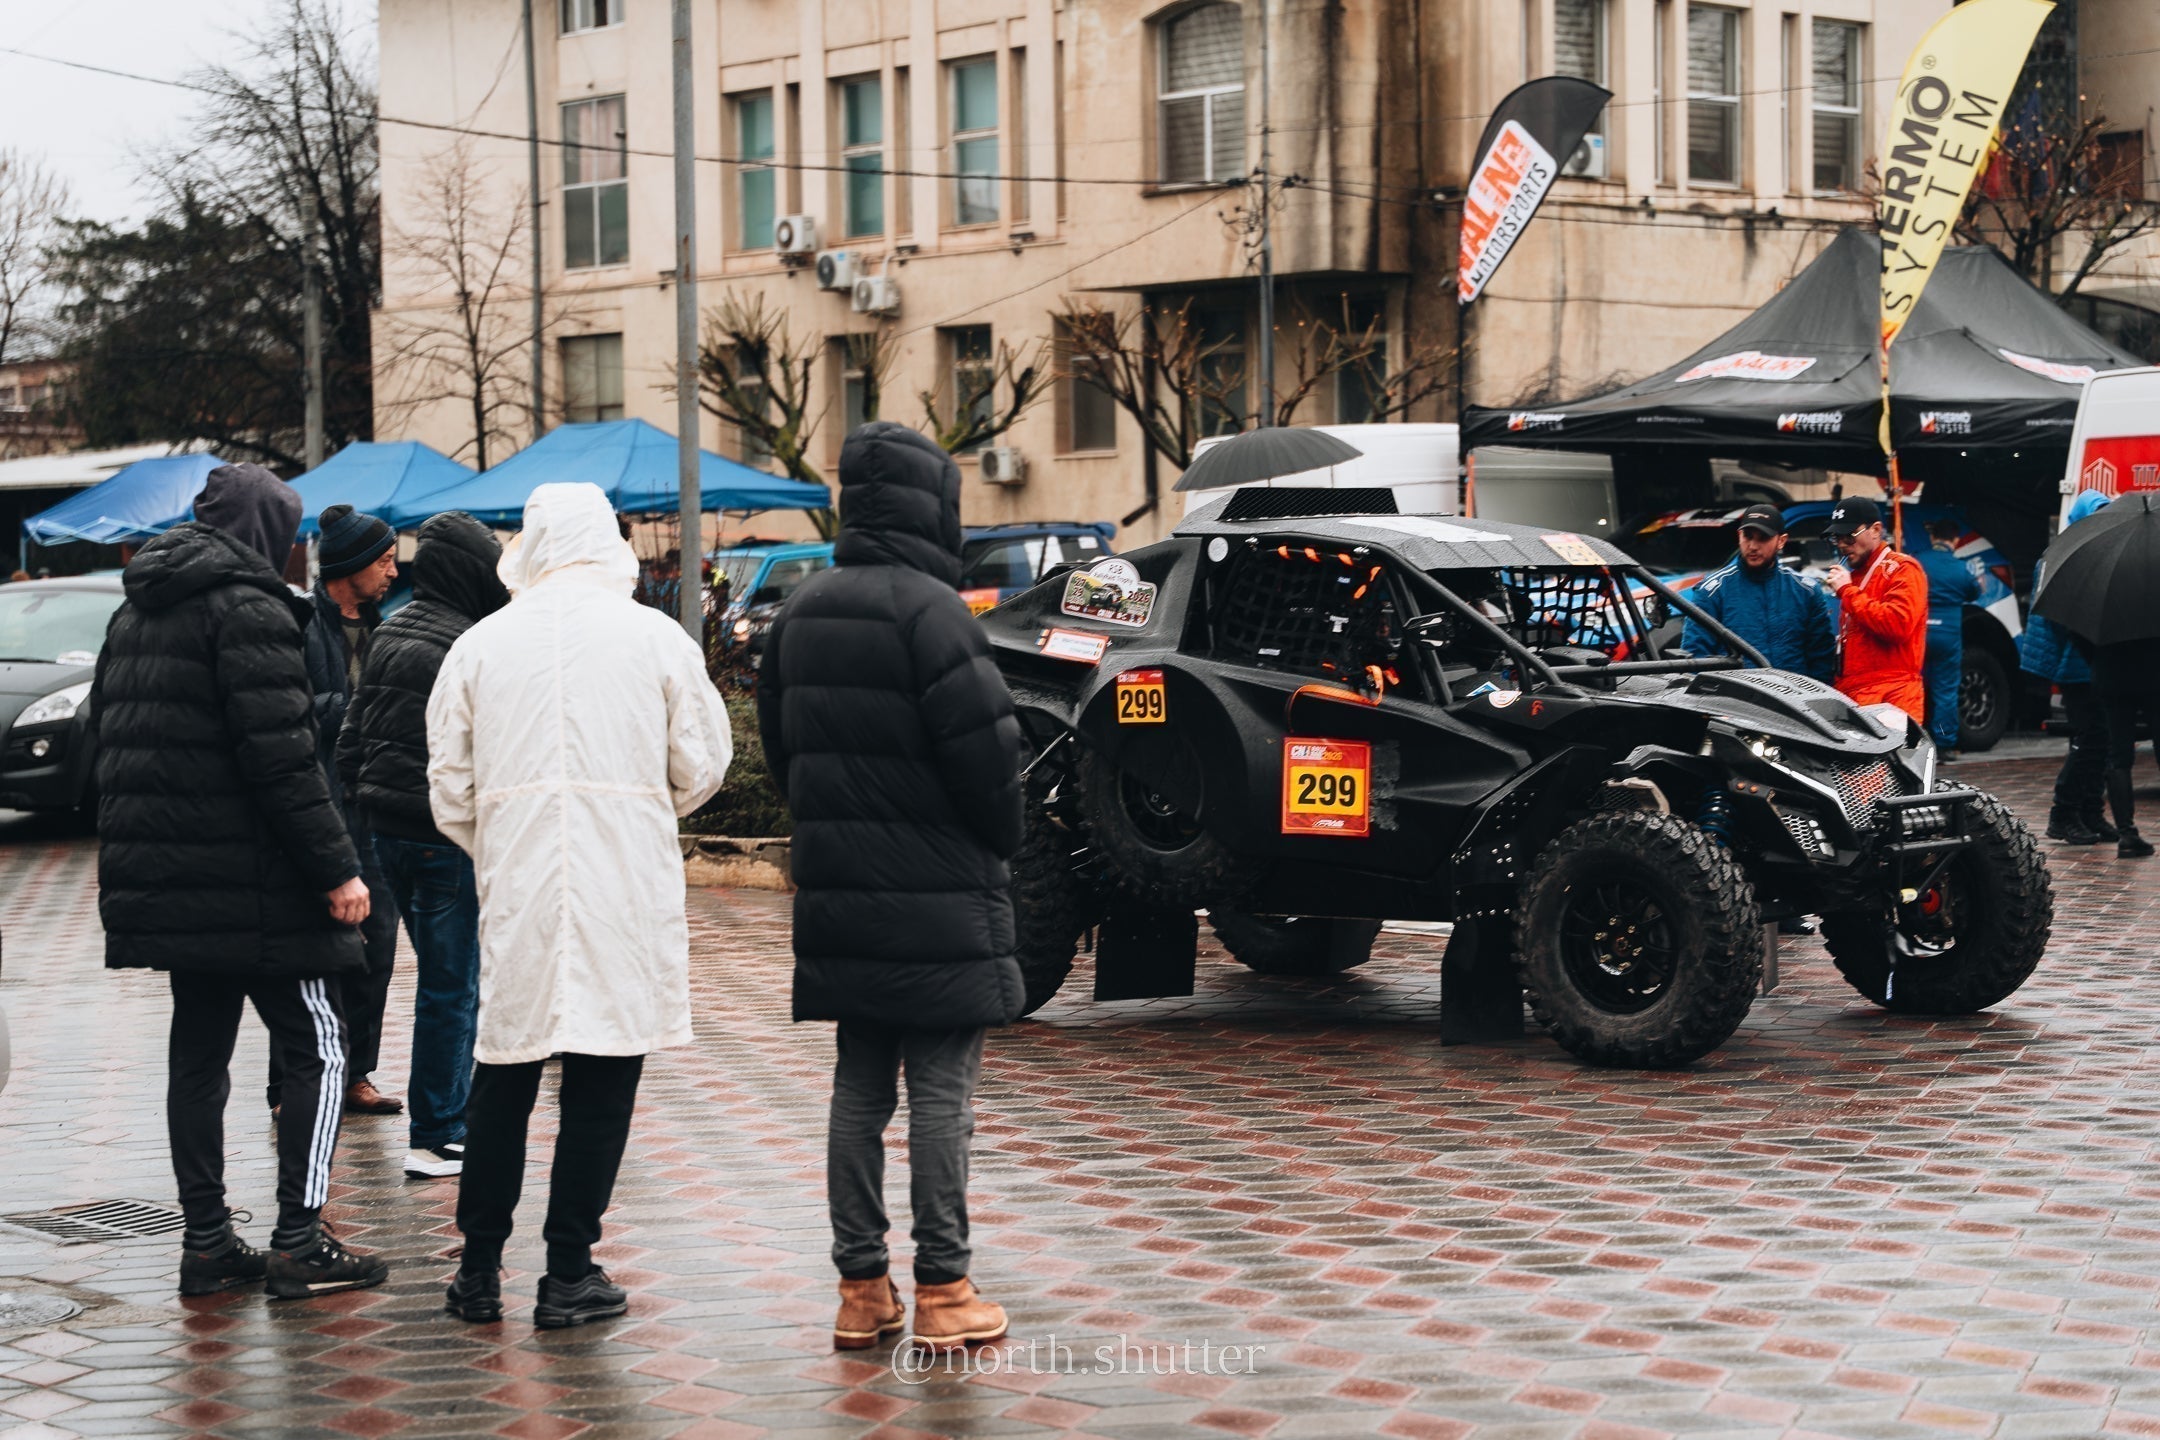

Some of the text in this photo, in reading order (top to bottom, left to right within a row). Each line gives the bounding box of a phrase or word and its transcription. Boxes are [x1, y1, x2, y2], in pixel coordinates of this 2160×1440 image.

[1882, 90, 1999, 314] SYSTEM
[1795, 423, 1841, 434] SYSTEM
[1120, 689, 1162, 718] 299
[1298, 773, 1356, 807] 299
